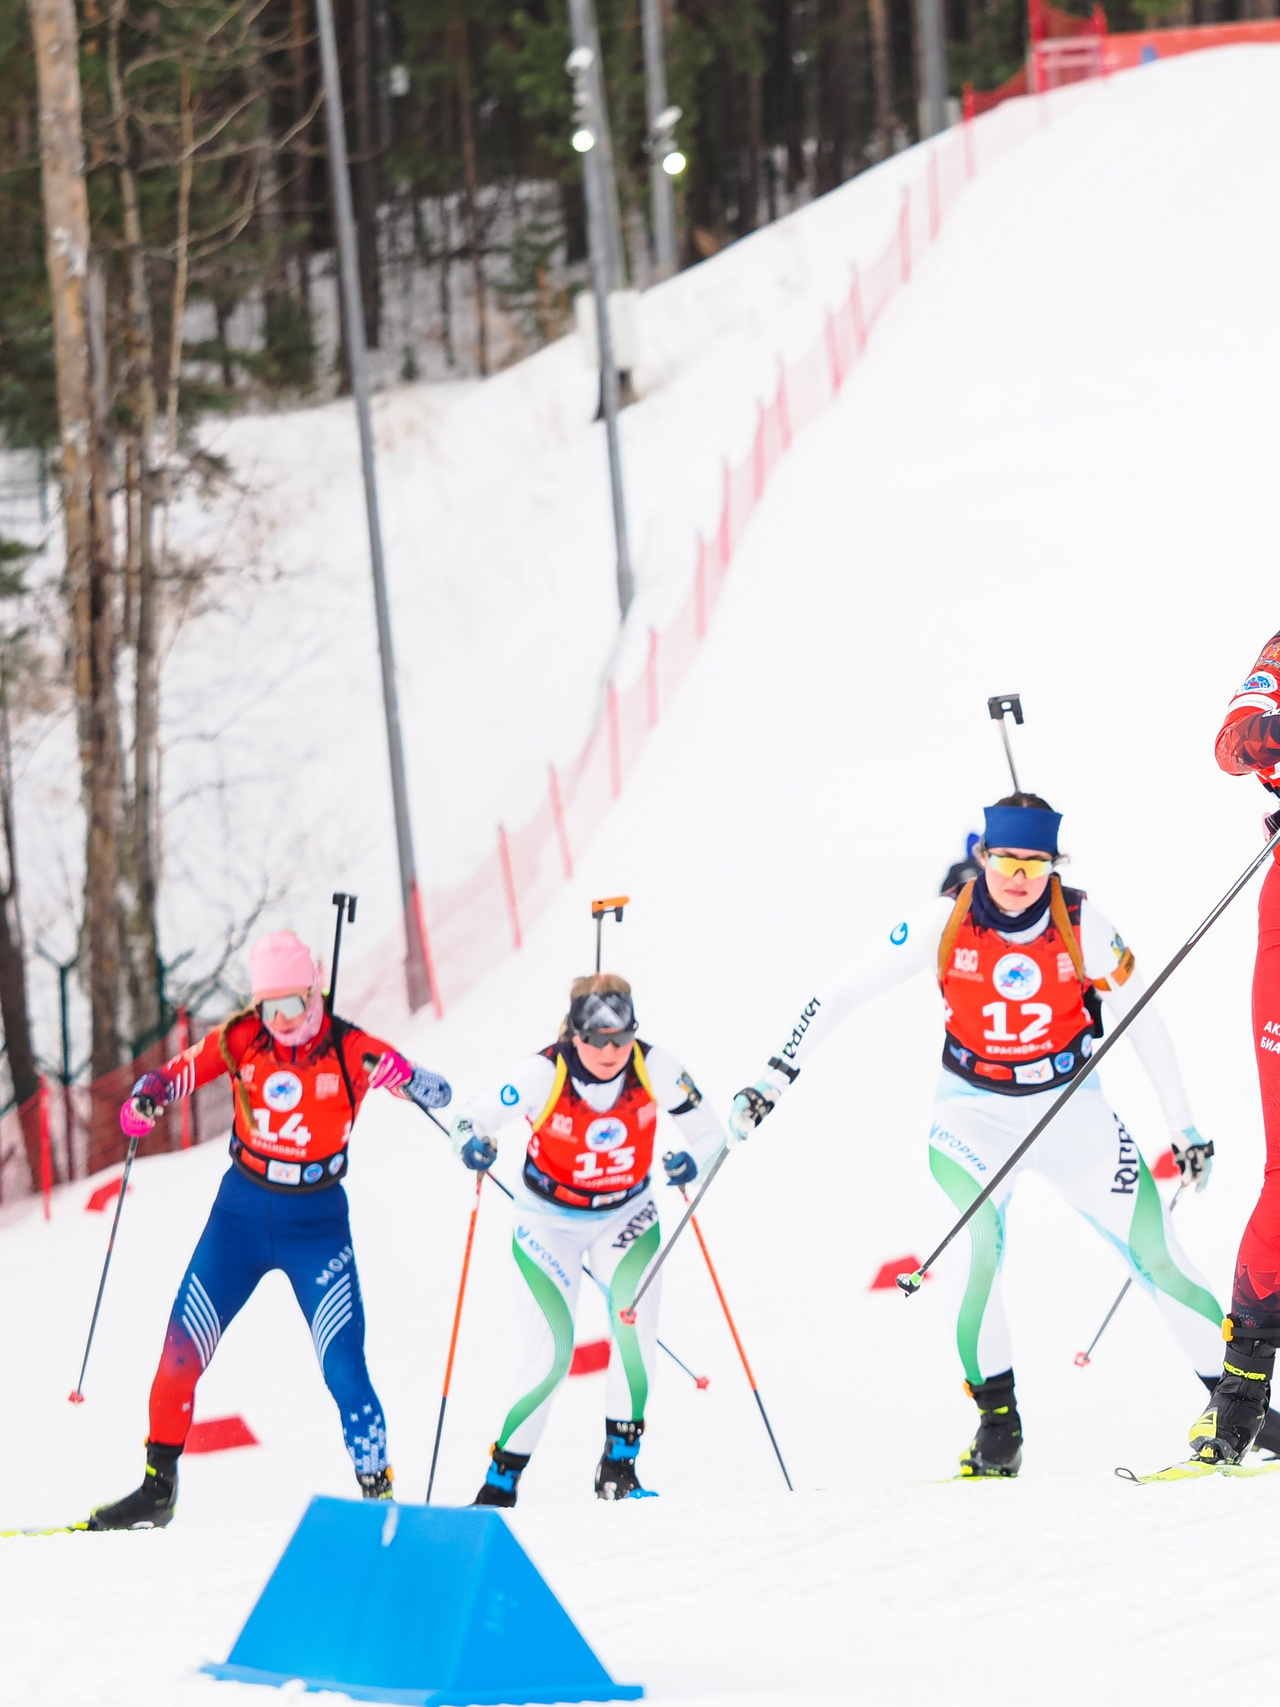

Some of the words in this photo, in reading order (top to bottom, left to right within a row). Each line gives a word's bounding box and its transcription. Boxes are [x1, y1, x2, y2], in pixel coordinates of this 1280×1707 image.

[982, 1001, 1052, 1044] 12
[250, 1108, 312, 1147] 14
[573, 1146, 636, 1180] 13
